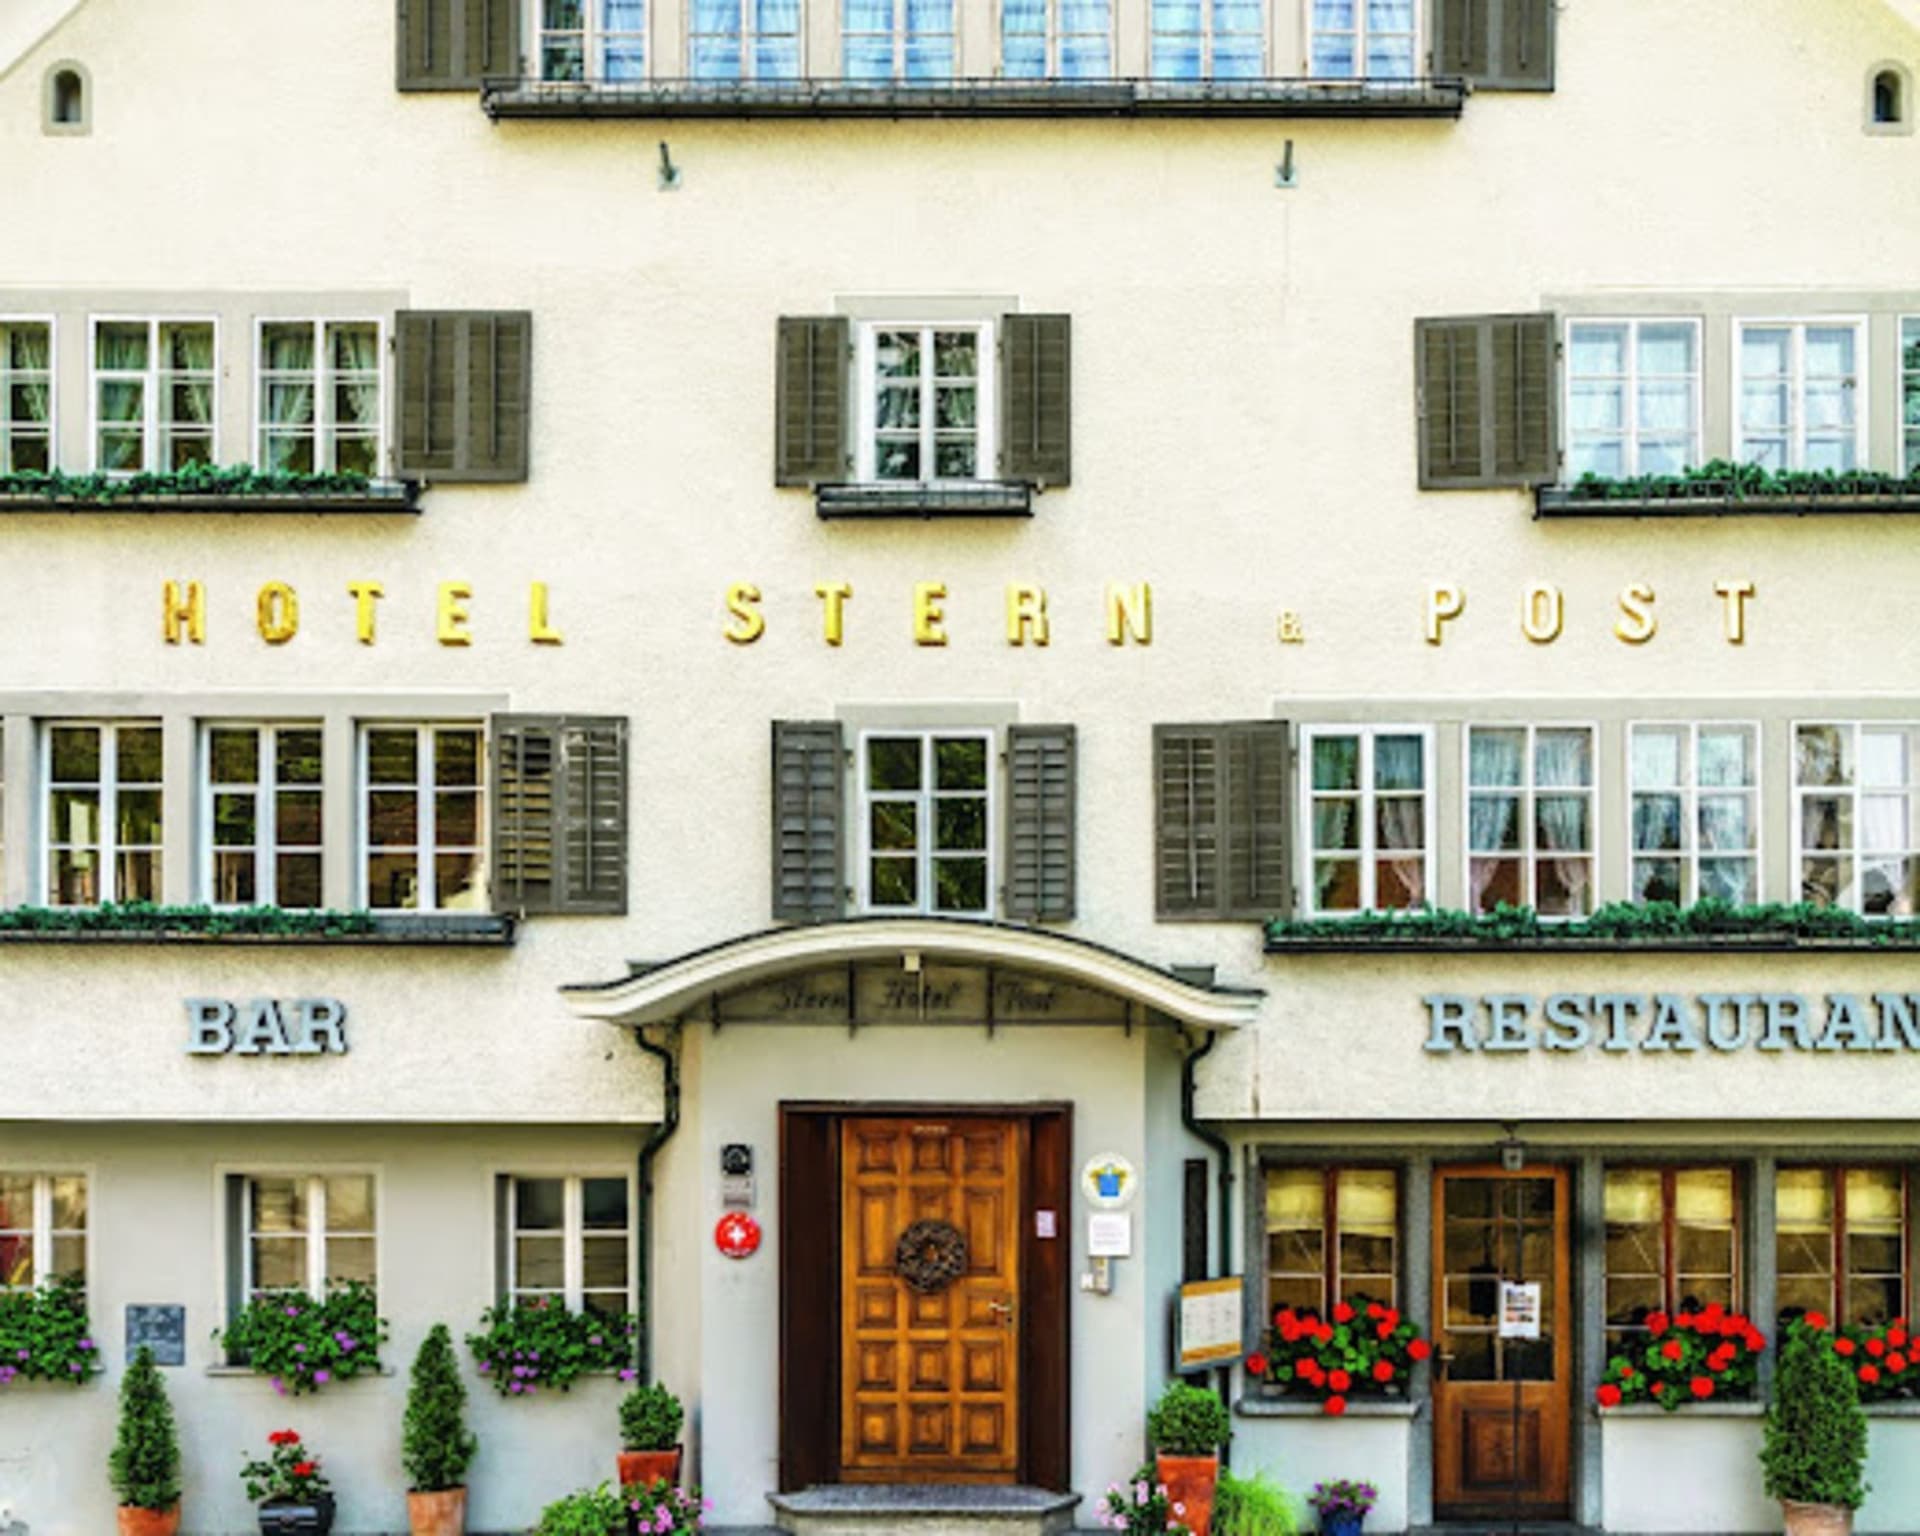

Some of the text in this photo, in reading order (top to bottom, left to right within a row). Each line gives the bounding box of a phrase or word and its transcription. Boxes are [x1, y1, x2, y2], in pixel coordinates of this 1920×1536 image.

[163, 579, 1757, 647] HOTEL STERN & POST
[184, 997, 350, 1057] BAR
[1422, 994, 1920, 1053] RESTAURAN
